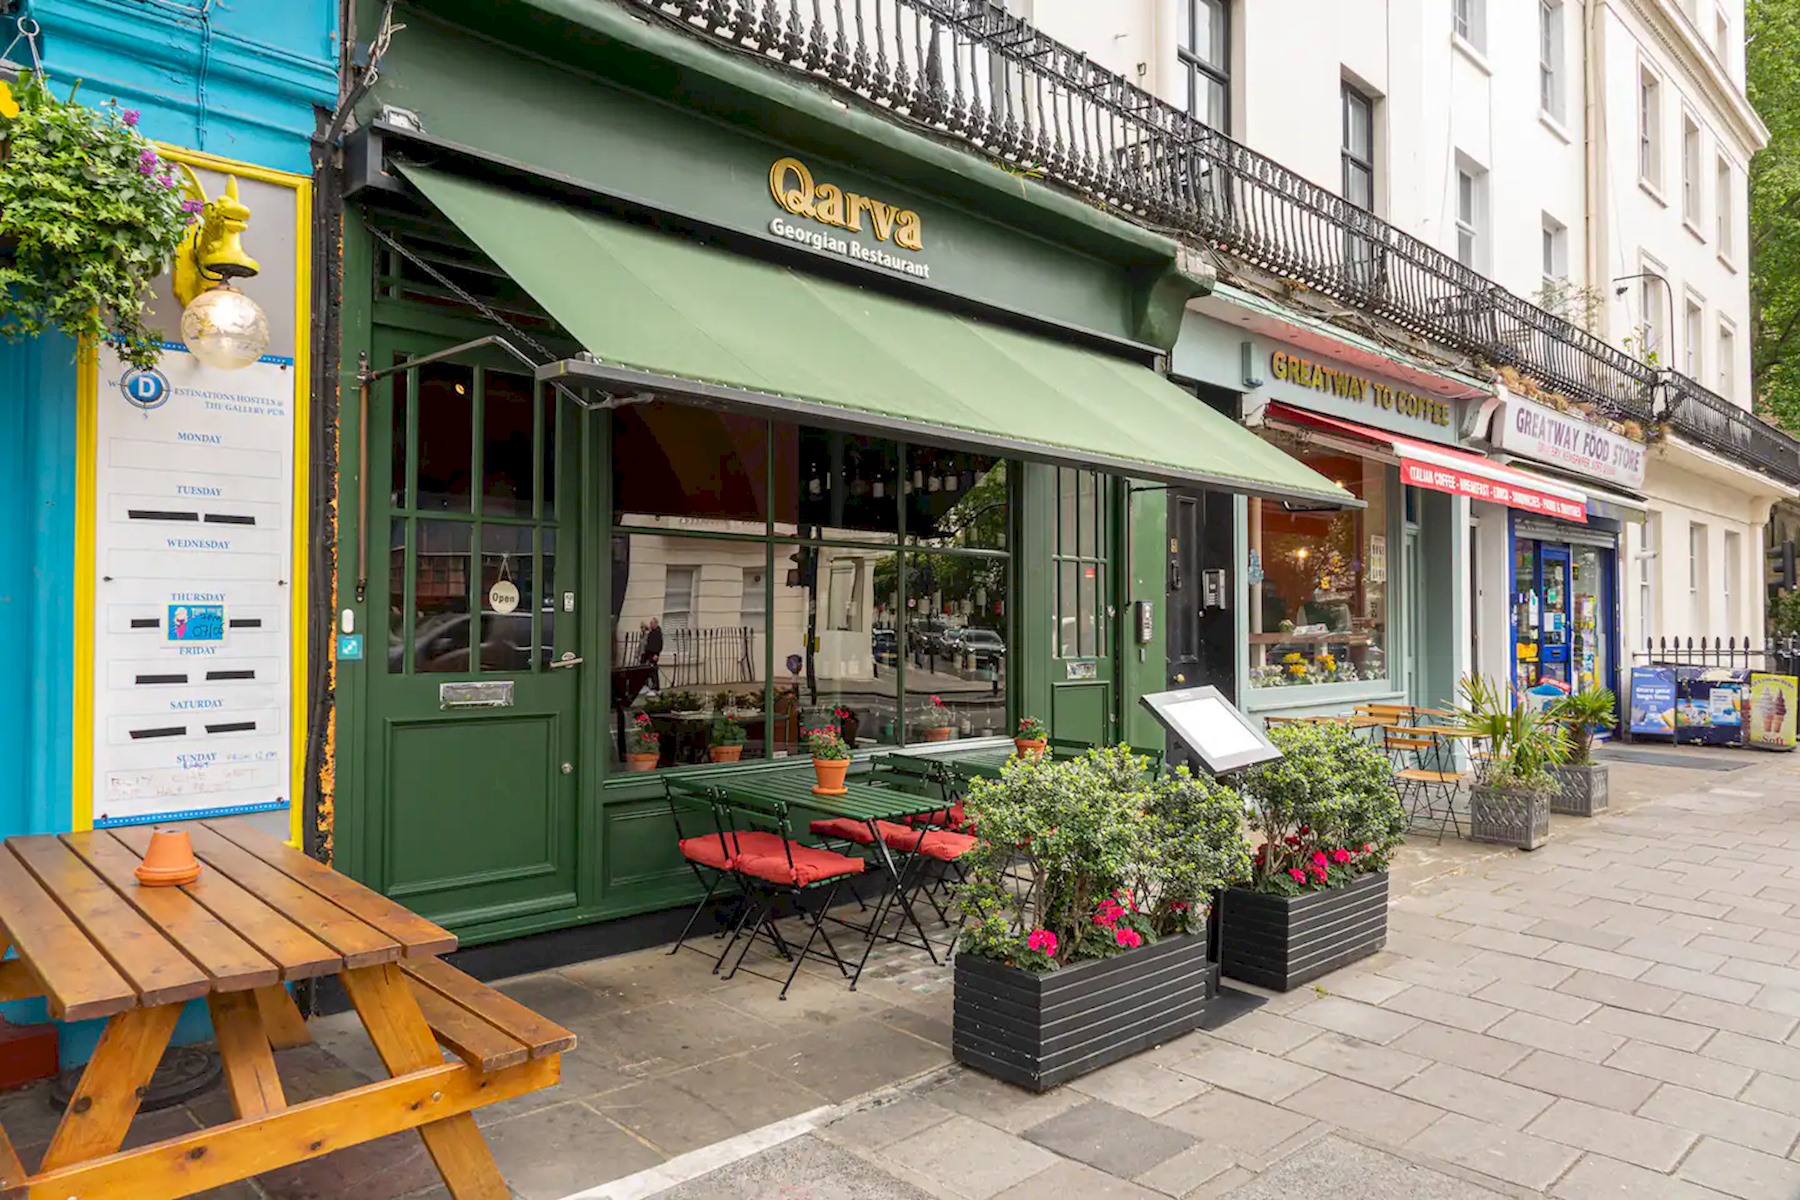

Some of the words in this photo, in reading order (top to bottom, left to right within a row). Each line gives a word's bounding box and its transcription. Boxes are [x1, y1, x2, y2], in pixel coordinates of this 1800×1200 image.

[769, 157, 924, 250] Qarva
[769, 218, 848, 253] Georgian
[850, 240, 930, 279] Restaurant
[1271, 351, 1370, 401] GREATWAY
[1372, 382, 1394, 411] TO
[1397, 390, 1451, 427] COFFEE
[237, 395, 276, 406] HOSTELS
[225, 404, 264, 415] GALLERY
[267, 408, 285, 416] PUB
[177, 432, 222, 443] MONDAY
[1516, 407, 1580, 451] GREATWAY
[1583, 433, 1609, 460] FOOD
[1613, 444, 1640, 472] STORE
[1409, 466, 1434, 483] ITALIAN
[1434, 471, 1456, 490] COFFEE
[176, 485, 222, 496] TUESDAY
[167, 538, 230, 549] WEDNESDAY
[171, 593, 226, 601] THURSDAY
[492, 592, 515, 604] Open
[179, 646, 216, 655] FRIDAY
[170, 699, 223, 709] SATURDAY
[176, 752, 217, 763] SUNDAY
